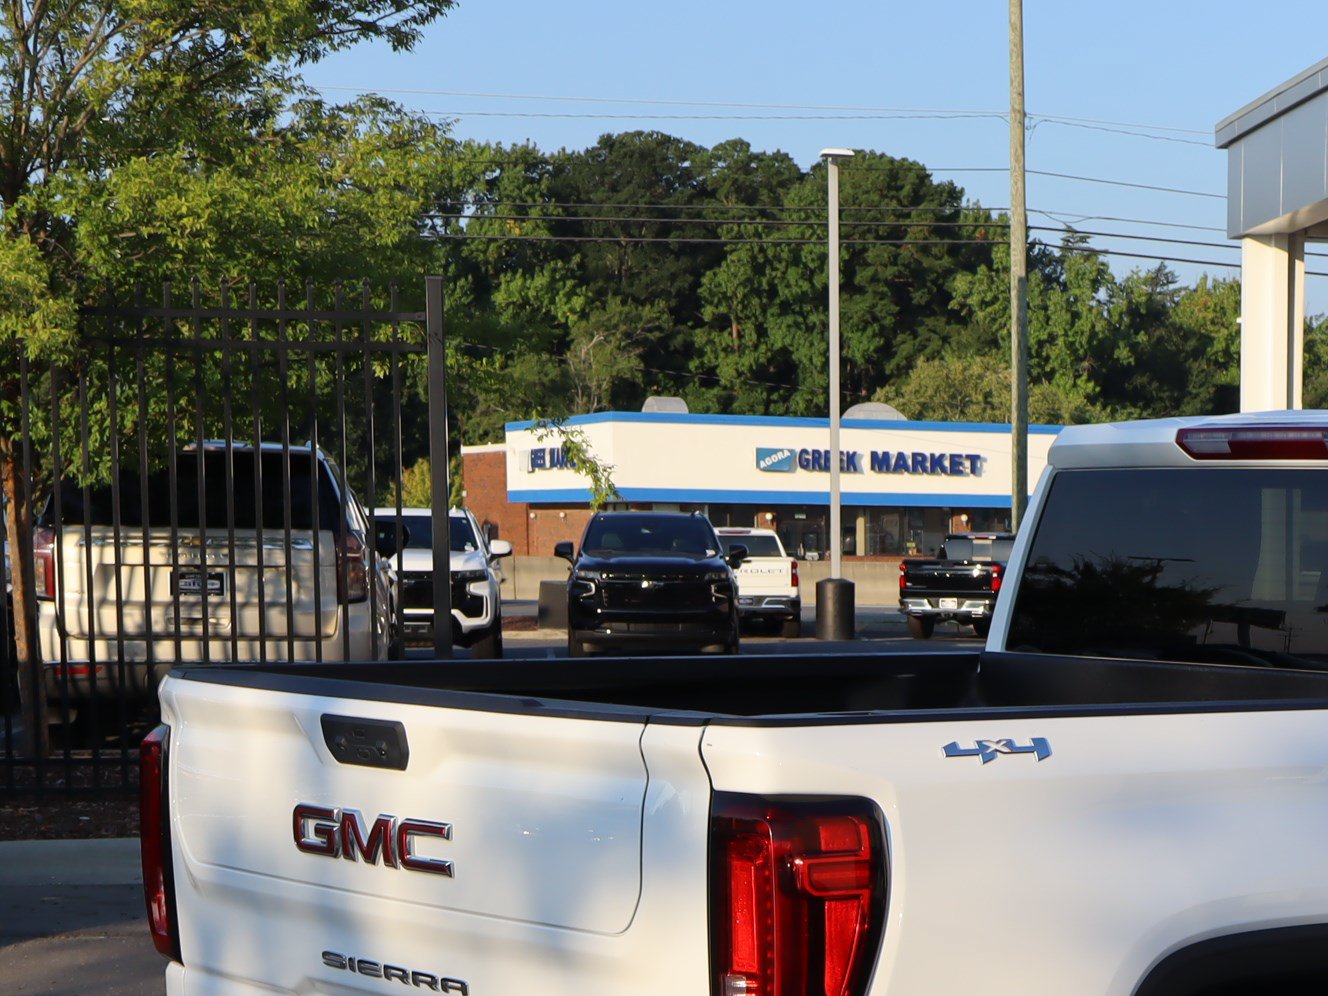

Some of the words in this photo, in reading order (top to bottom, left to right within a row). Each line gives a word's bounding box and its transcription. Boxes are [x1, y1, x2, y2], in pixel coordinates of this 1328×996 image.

[759, 449, 791, 469] AGORA
[870, 451, 982, 475] MARKET
[293, 802, 455, 879] GMC
[321, 950, 470, 996] SIERRA
